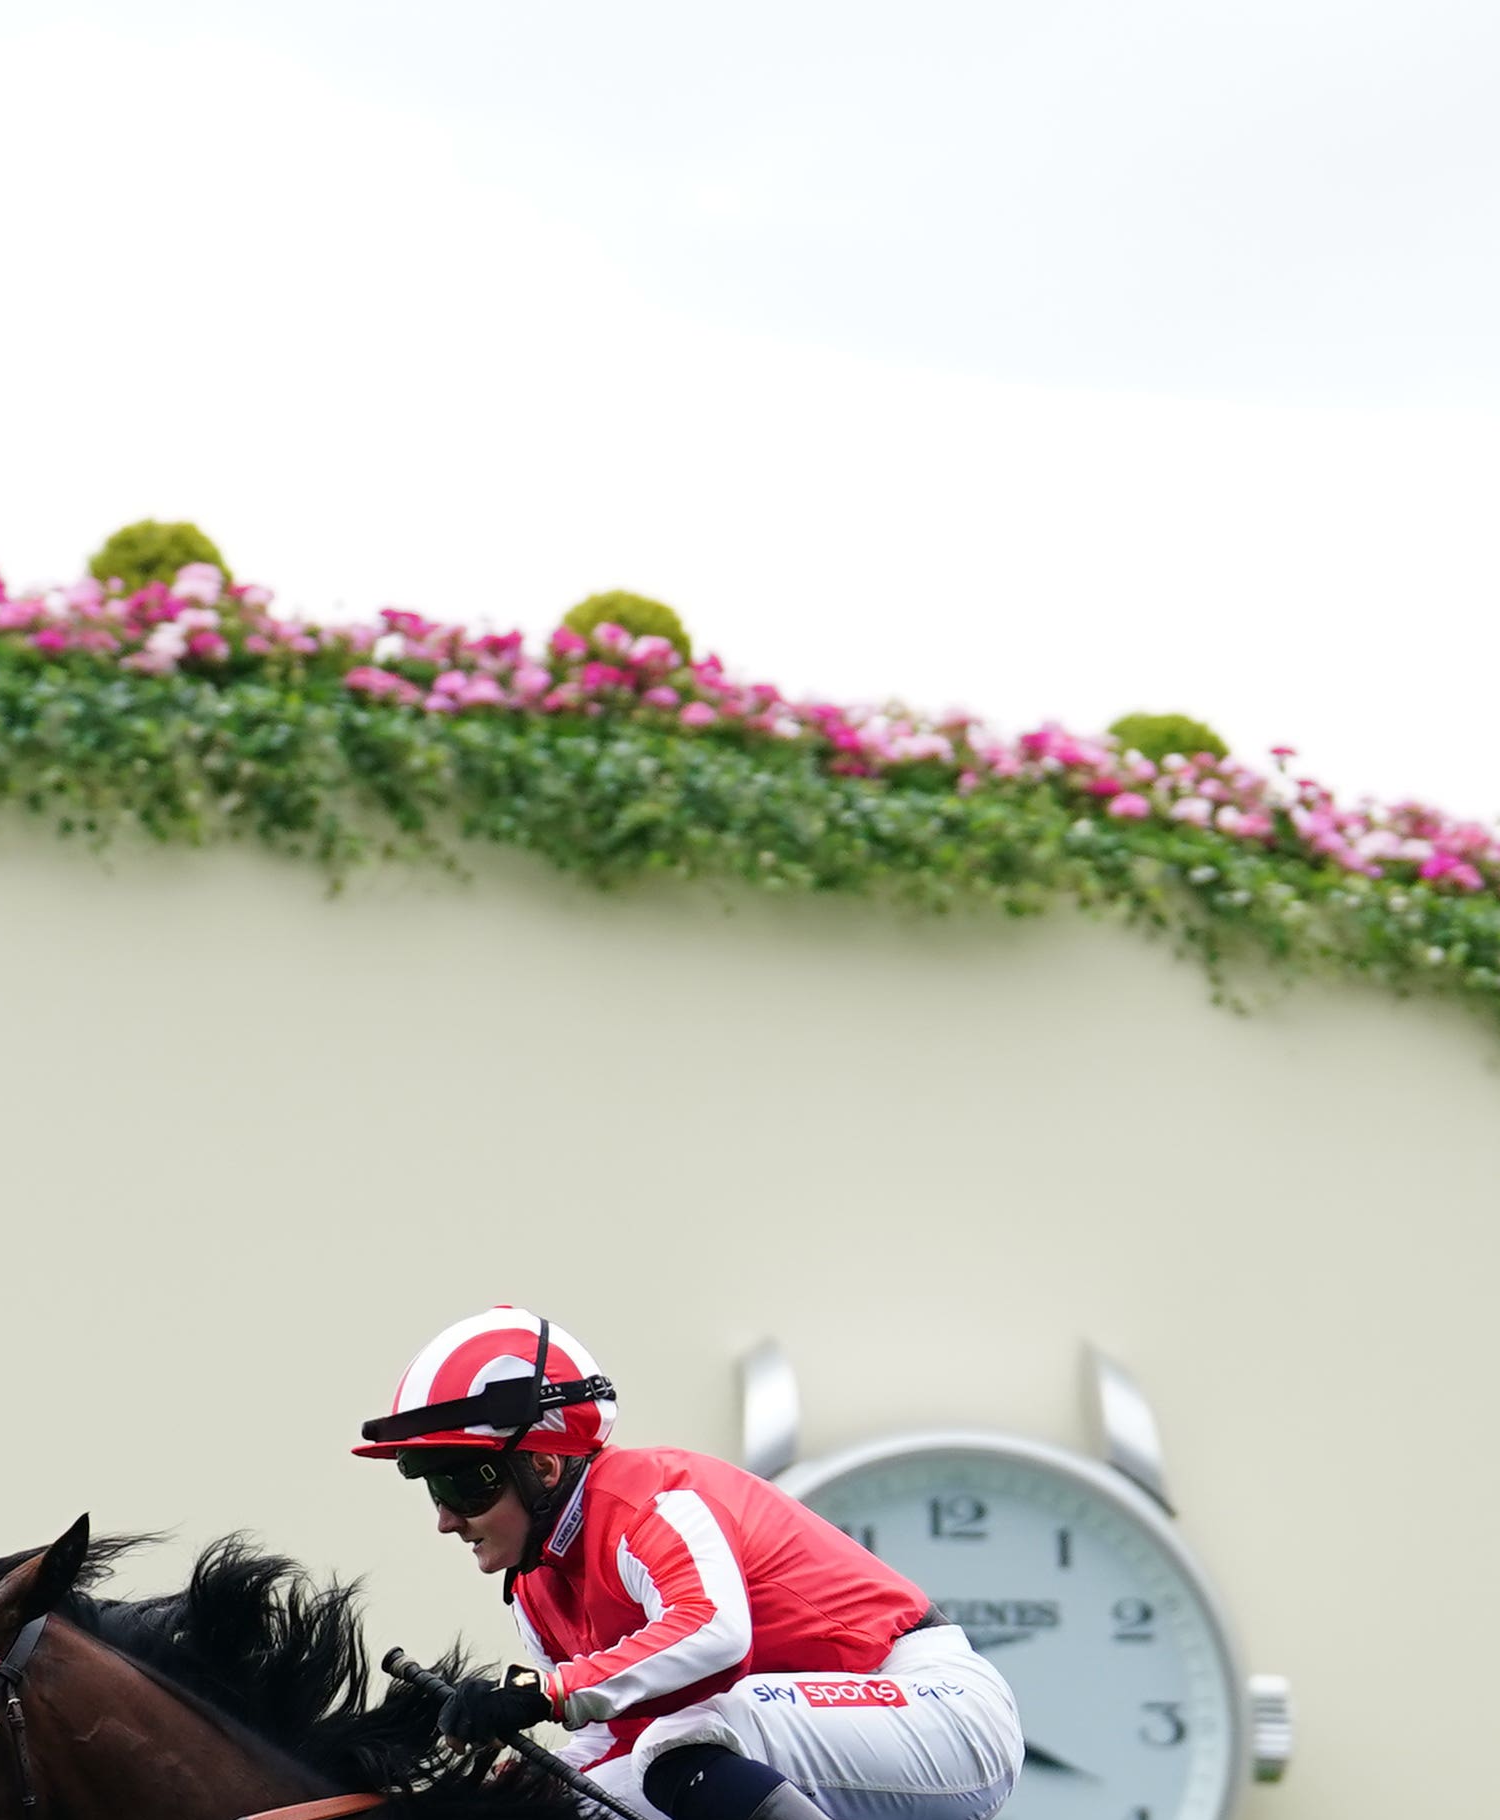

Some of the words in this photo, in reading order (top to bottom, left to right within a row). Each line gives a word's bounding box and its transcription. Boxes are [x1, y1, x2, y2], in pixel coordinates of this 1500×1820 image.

[930, 1497, 989, 1540] 12
[1055, 1527, 1073, 1569] 1
[1112, 1600, 1154, 1642] 2
[753, 1684, 797, 1704] sky
[1141, 1701, 1187, 1748] 3
